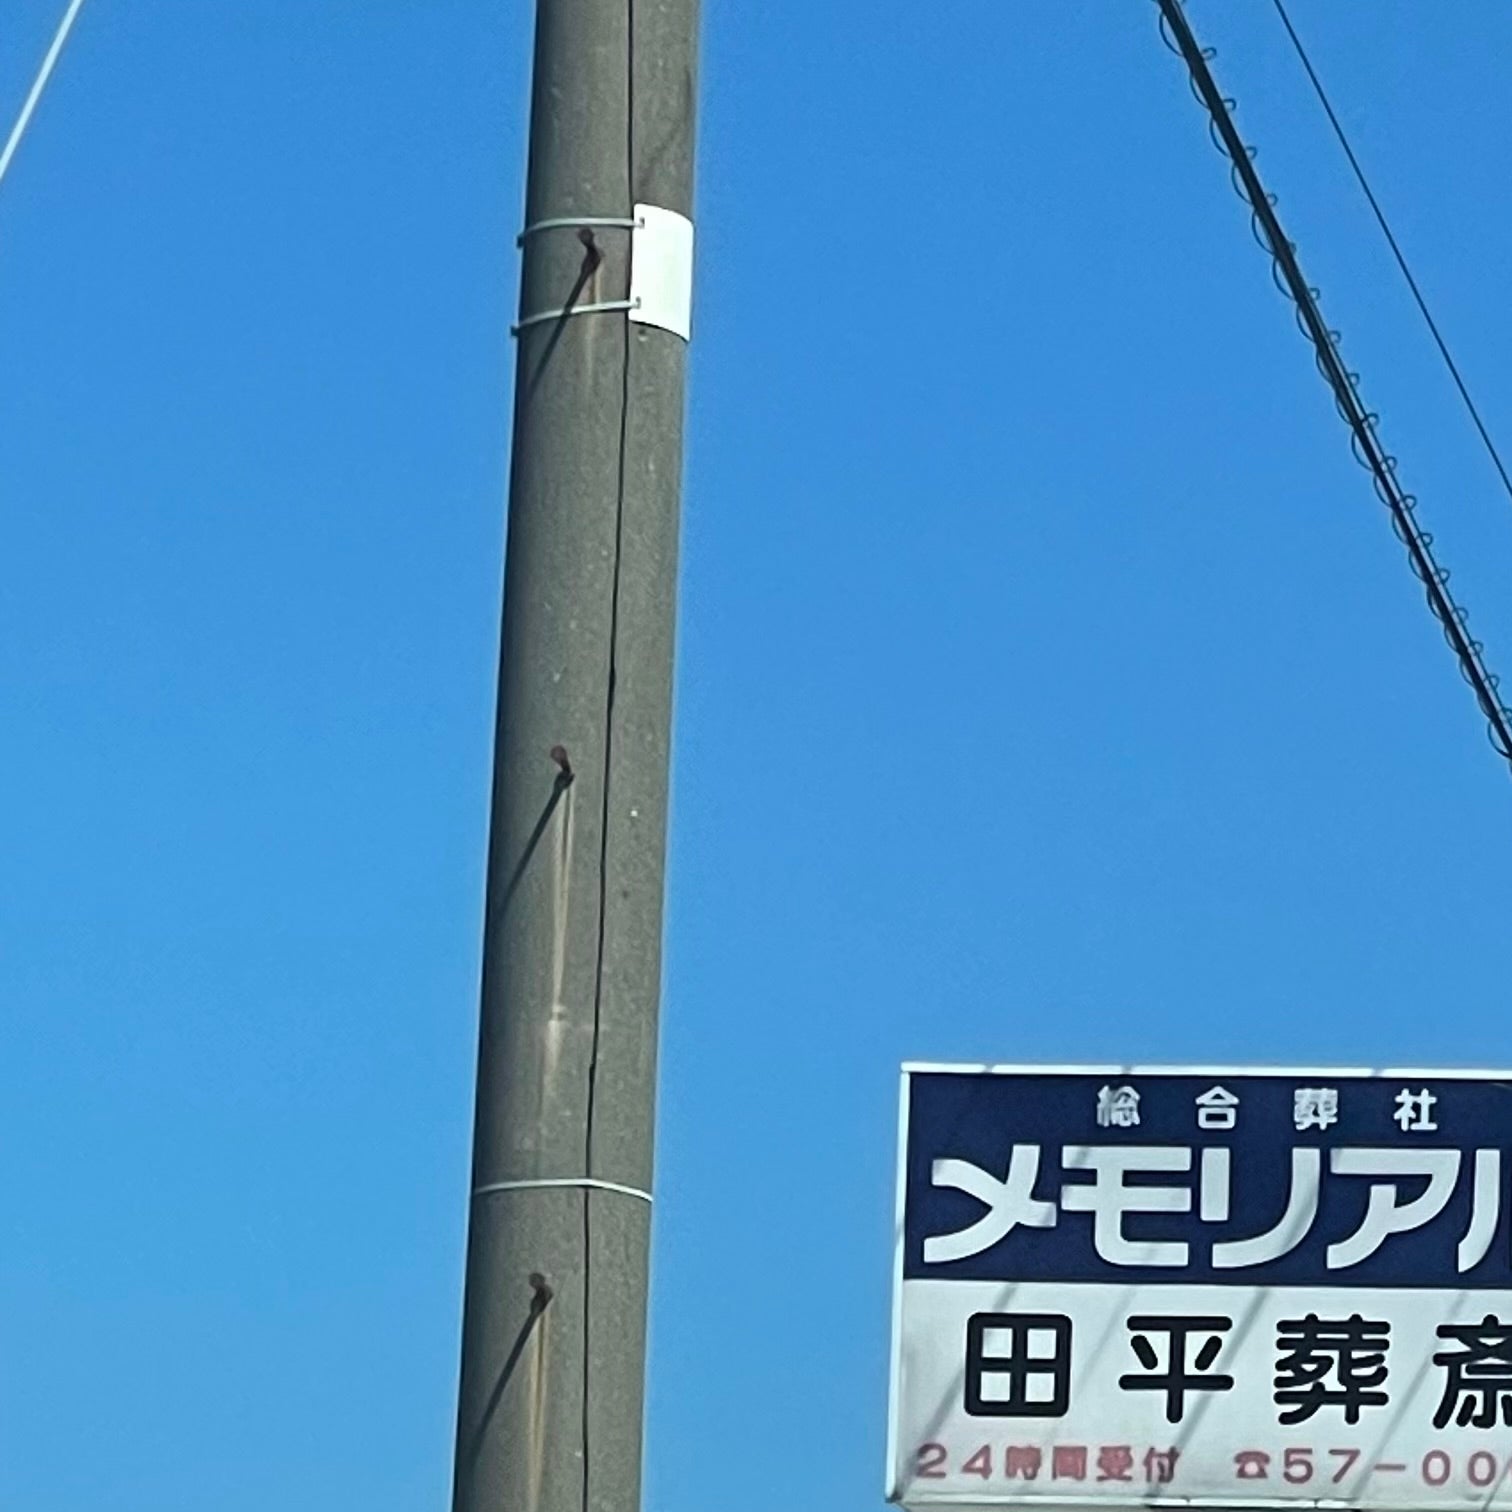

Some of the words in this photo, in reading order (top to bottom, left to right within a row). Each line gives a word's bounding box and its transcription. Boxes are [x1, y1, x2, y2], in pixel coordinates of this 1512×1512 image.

[1097, 1085, 1438, 1131] 総合葬社
[916, 1443, 1179, 1483] 24時間受付
